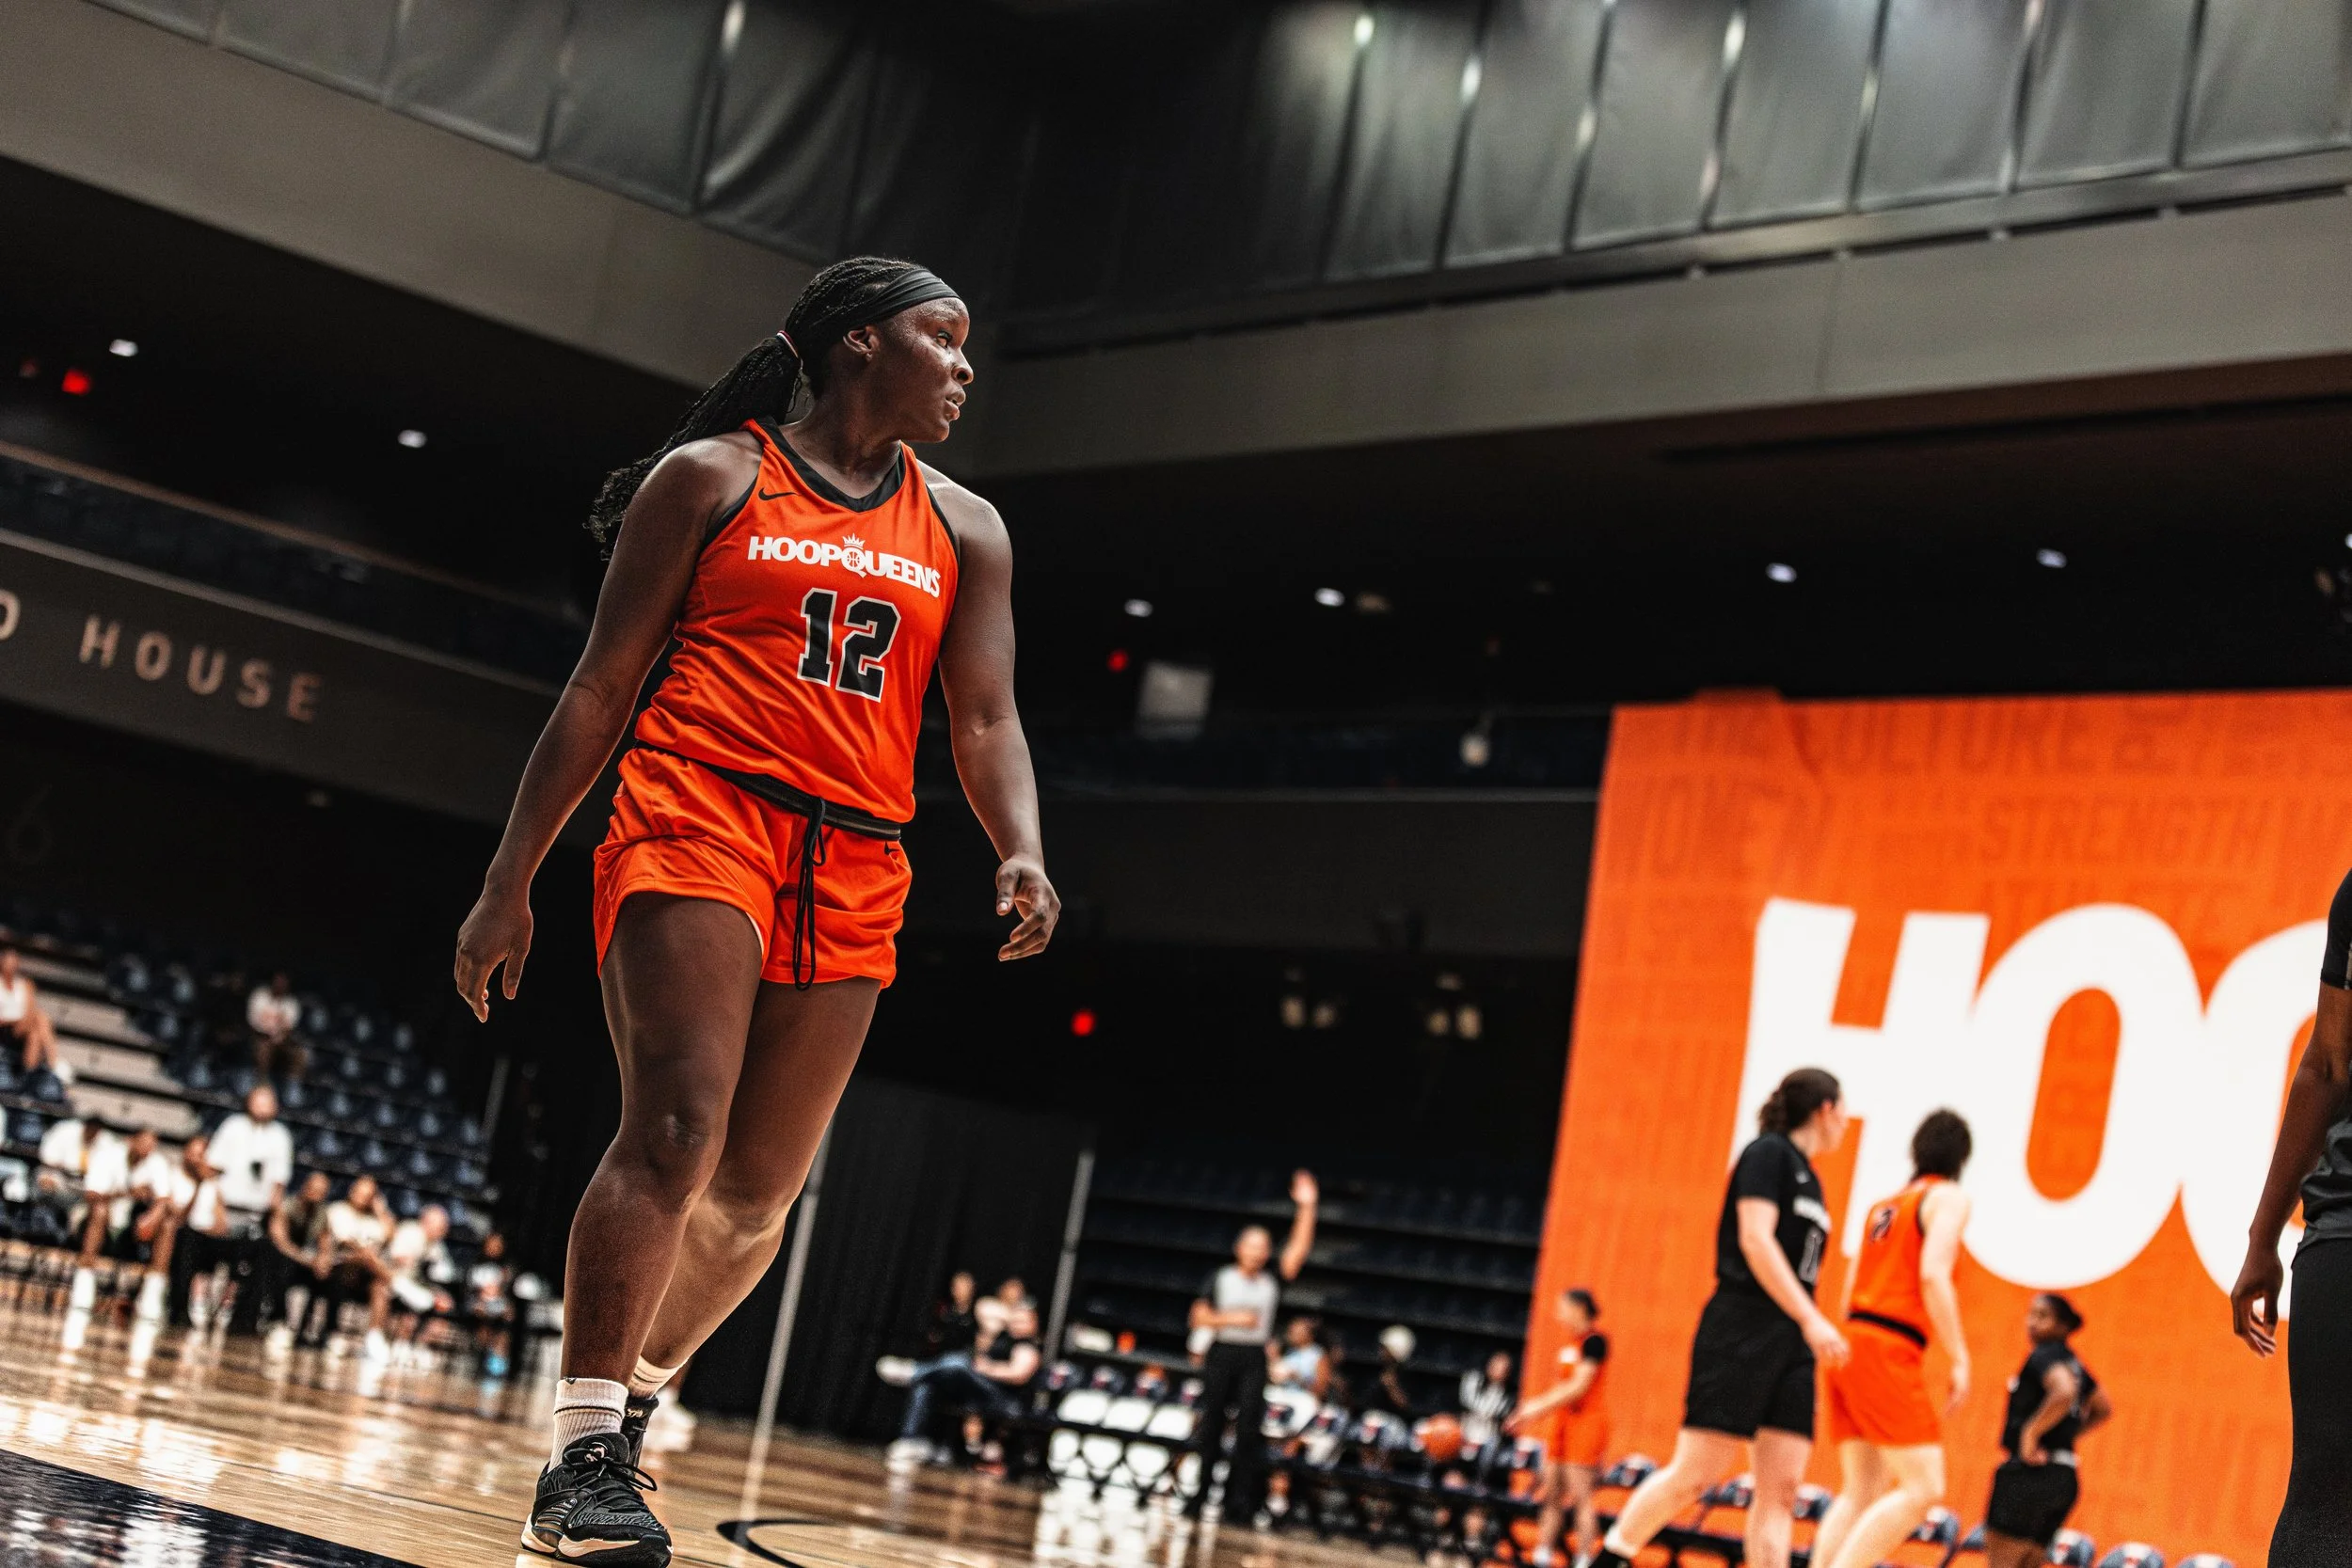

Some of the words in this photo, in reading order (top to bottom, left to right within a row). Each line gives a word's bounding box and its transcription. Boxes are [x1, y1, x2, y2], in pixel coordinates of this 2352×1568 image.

[748, 535, 941, 598] HOOPQUEENS
[78, 612, 326, 723] HOUSE
[797, 587, 901, 703] 12
